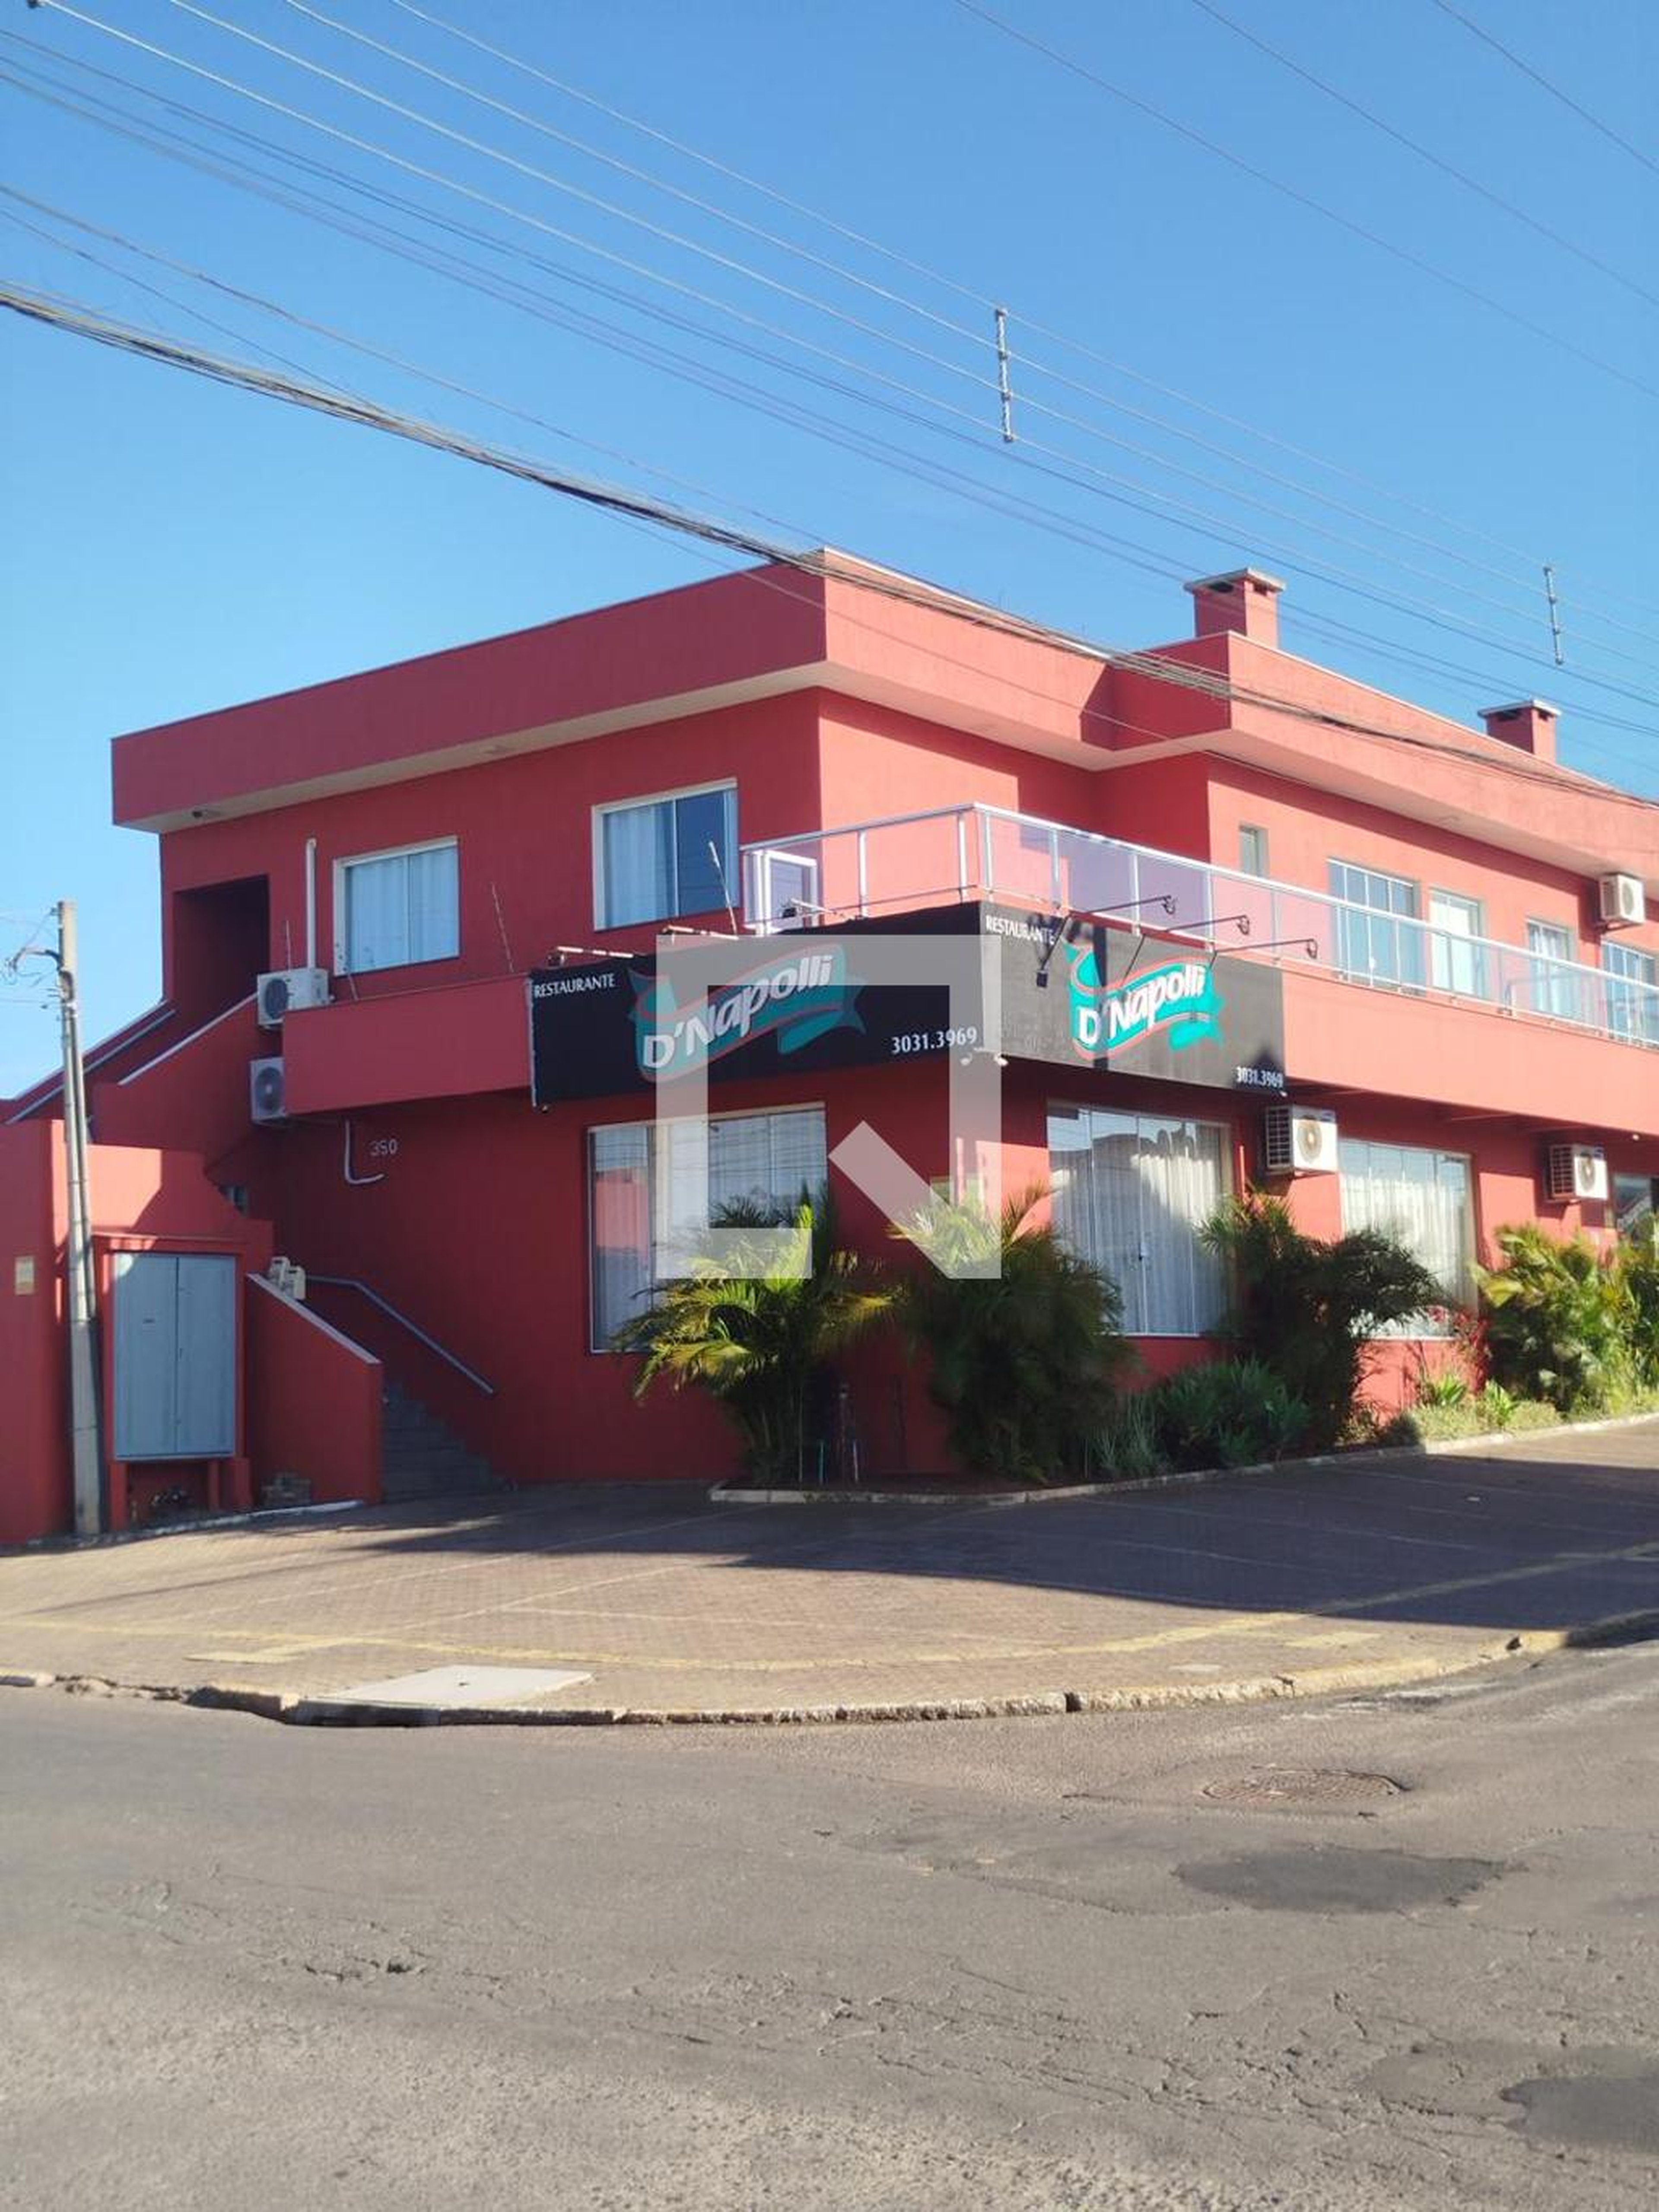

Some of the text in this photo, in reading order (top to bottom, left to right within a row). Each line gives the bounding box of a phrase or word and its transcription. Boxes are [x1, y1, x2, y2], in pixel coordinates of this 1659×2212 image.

[985, 916, 1056, 946] RESTAURANTE
[534, 973, 615, 999] RESTAURANTE
[644, 954, 833, 1069] D'Napolli
[1079, 964, 1206, 1044] D'Napolli
[891, 1027, 978, 1054] 3031.3969
